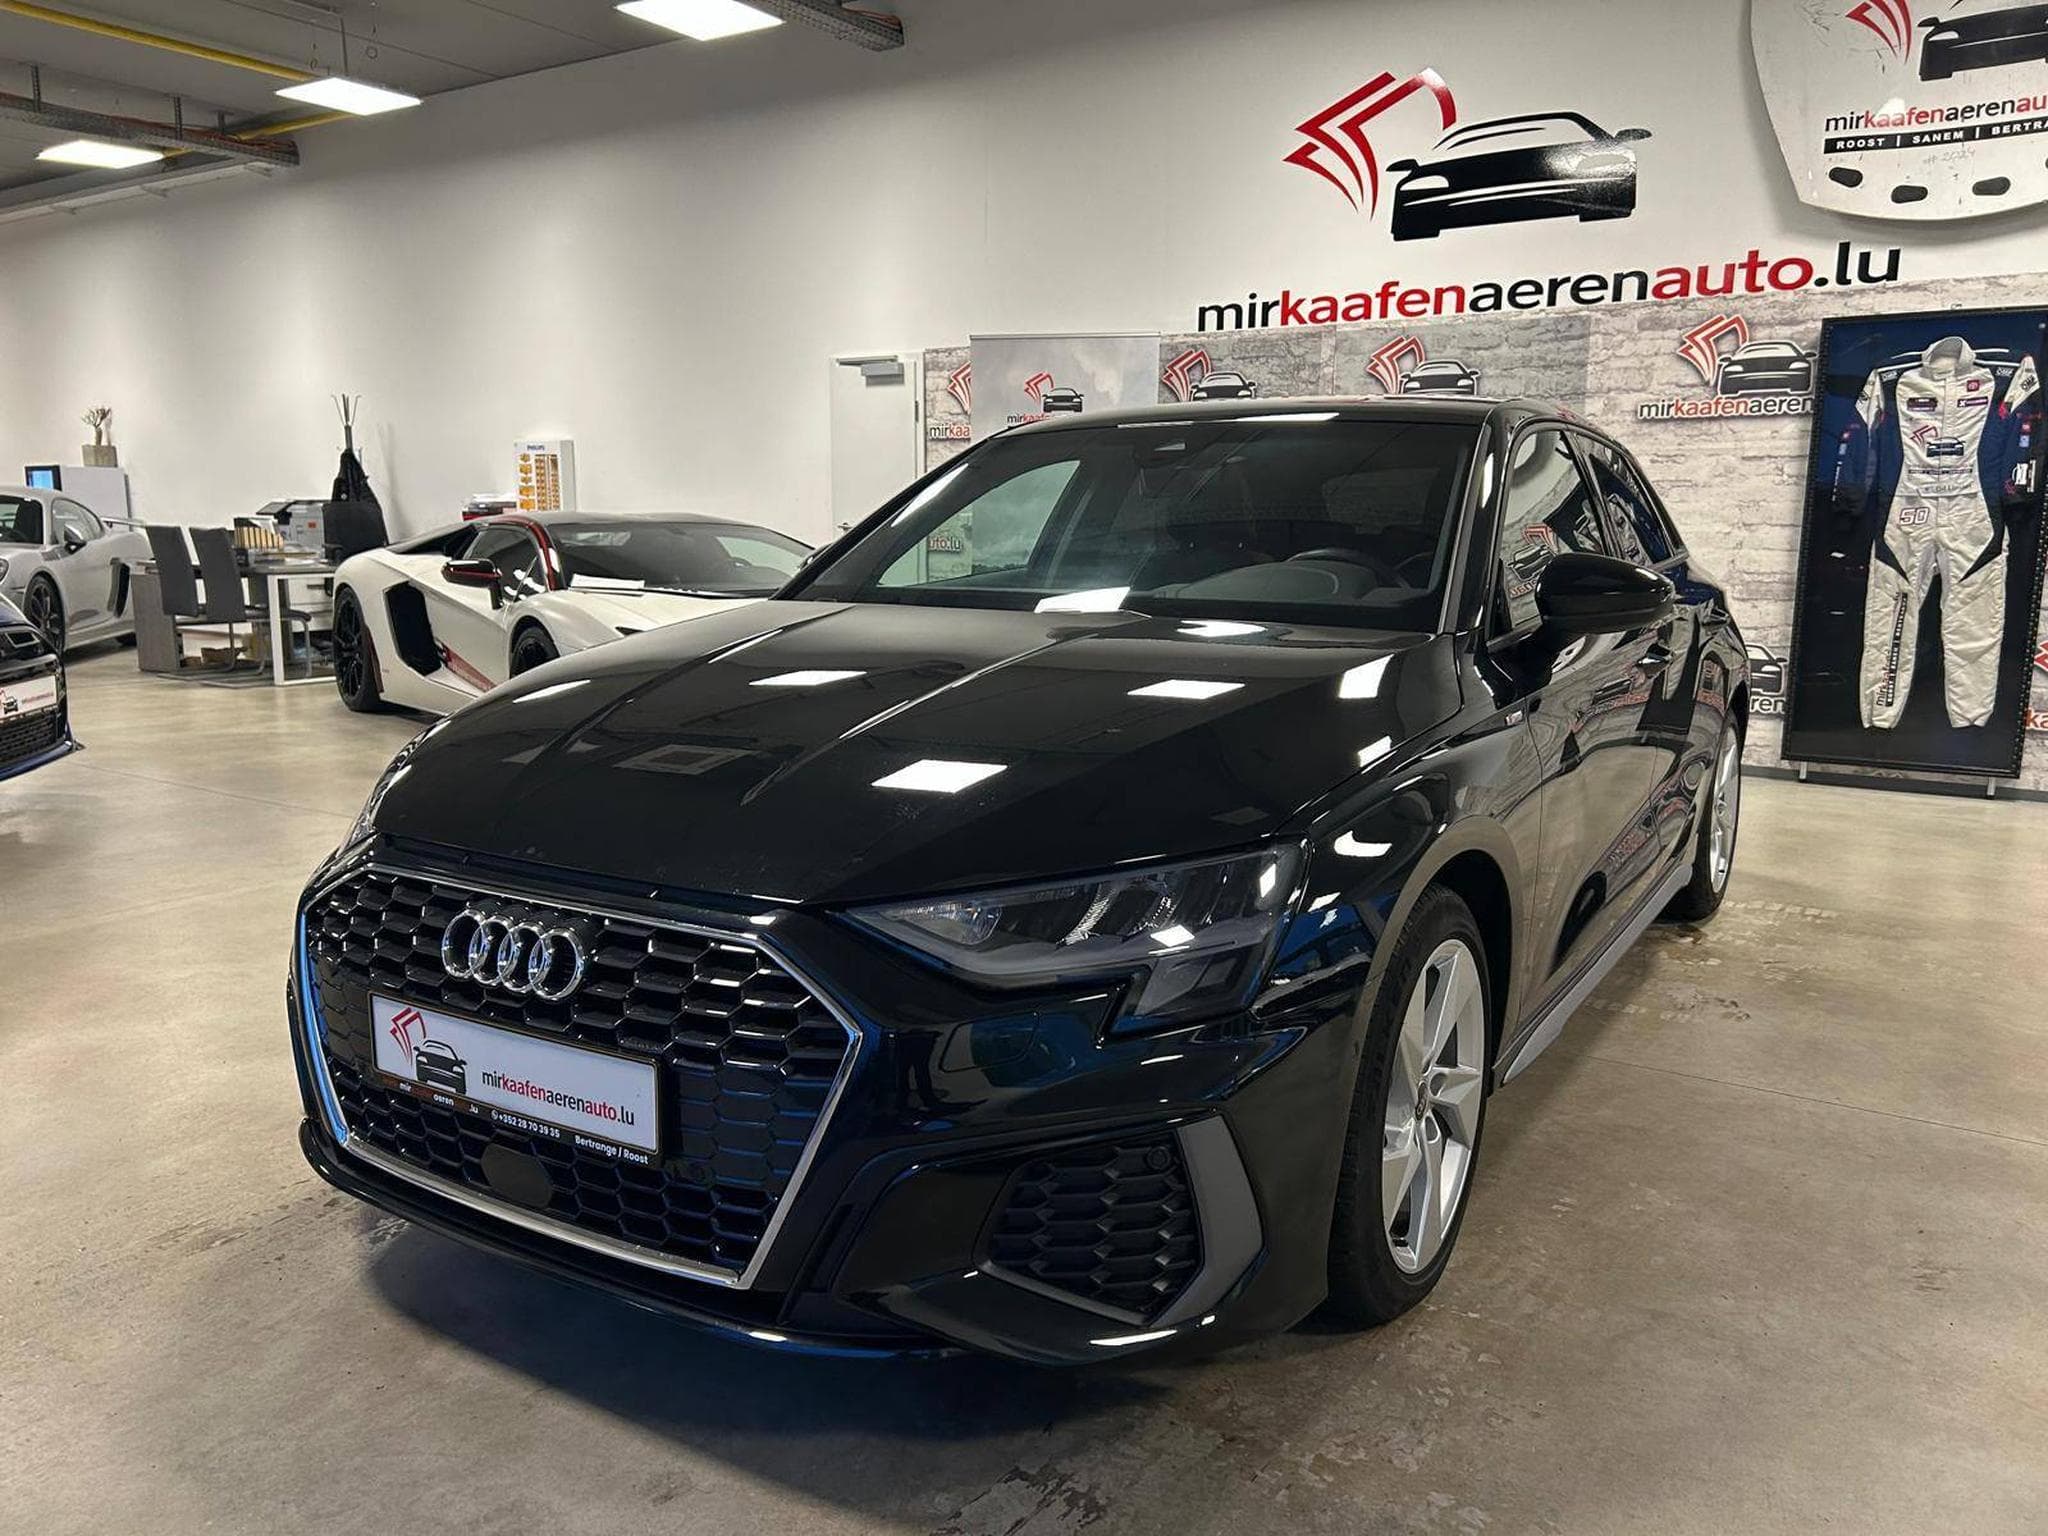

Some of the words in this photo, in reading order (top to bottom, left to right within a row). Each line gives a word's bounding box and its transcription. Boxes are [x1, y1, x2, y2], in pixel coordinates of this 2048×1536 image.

[1836, 137, 1885, 150] ROOST
[1912, 130, 1964, 144] SANEM
[1198, 241, 1901, 332] mirkaafenaerenauto.lu
[1900, 506, 1929, 526] 50
[482, 1070, 635, 1126] mirkaafenaerenauto.lu
[575, 1135, 617, 1157] Bertrange
[623, 1149, 649, 1165] Roost
